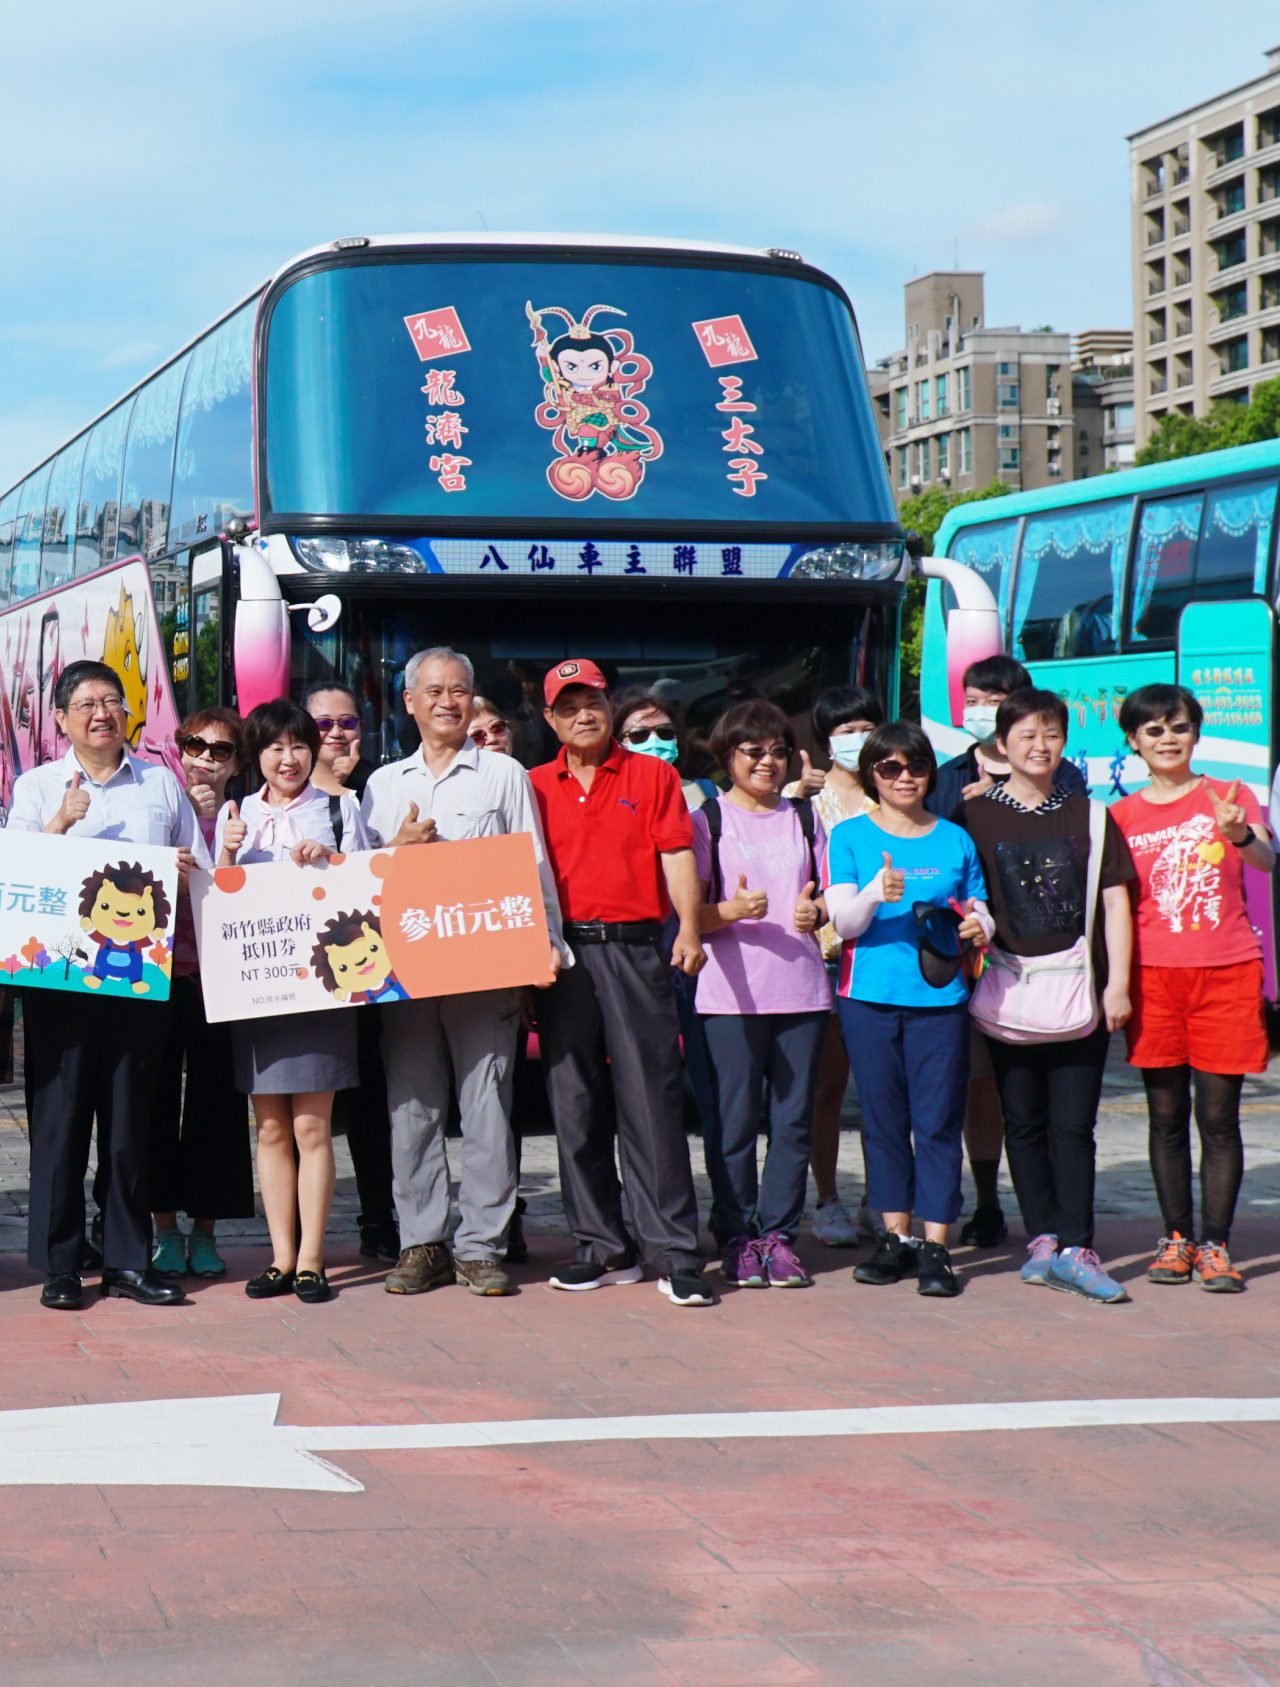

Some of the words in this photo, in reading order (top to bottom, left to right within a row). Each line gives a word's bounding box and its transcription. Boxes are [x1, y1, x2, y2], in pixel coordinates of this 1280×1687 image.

[421, 368, 471, 493] 龍濟宮
[715, 376, 768, 498] 三太子
[478, 542, 744, 576] 八仙車主聯盟
[1127, 825, 1179, 849] TAIWAN
[222, 913, 311, 940] 新竹縣政府
[399, 895, 536, 942] 參佰元整
[242, 939, 295, 960] 抵用券
[241, 969, 259, 981] NT
